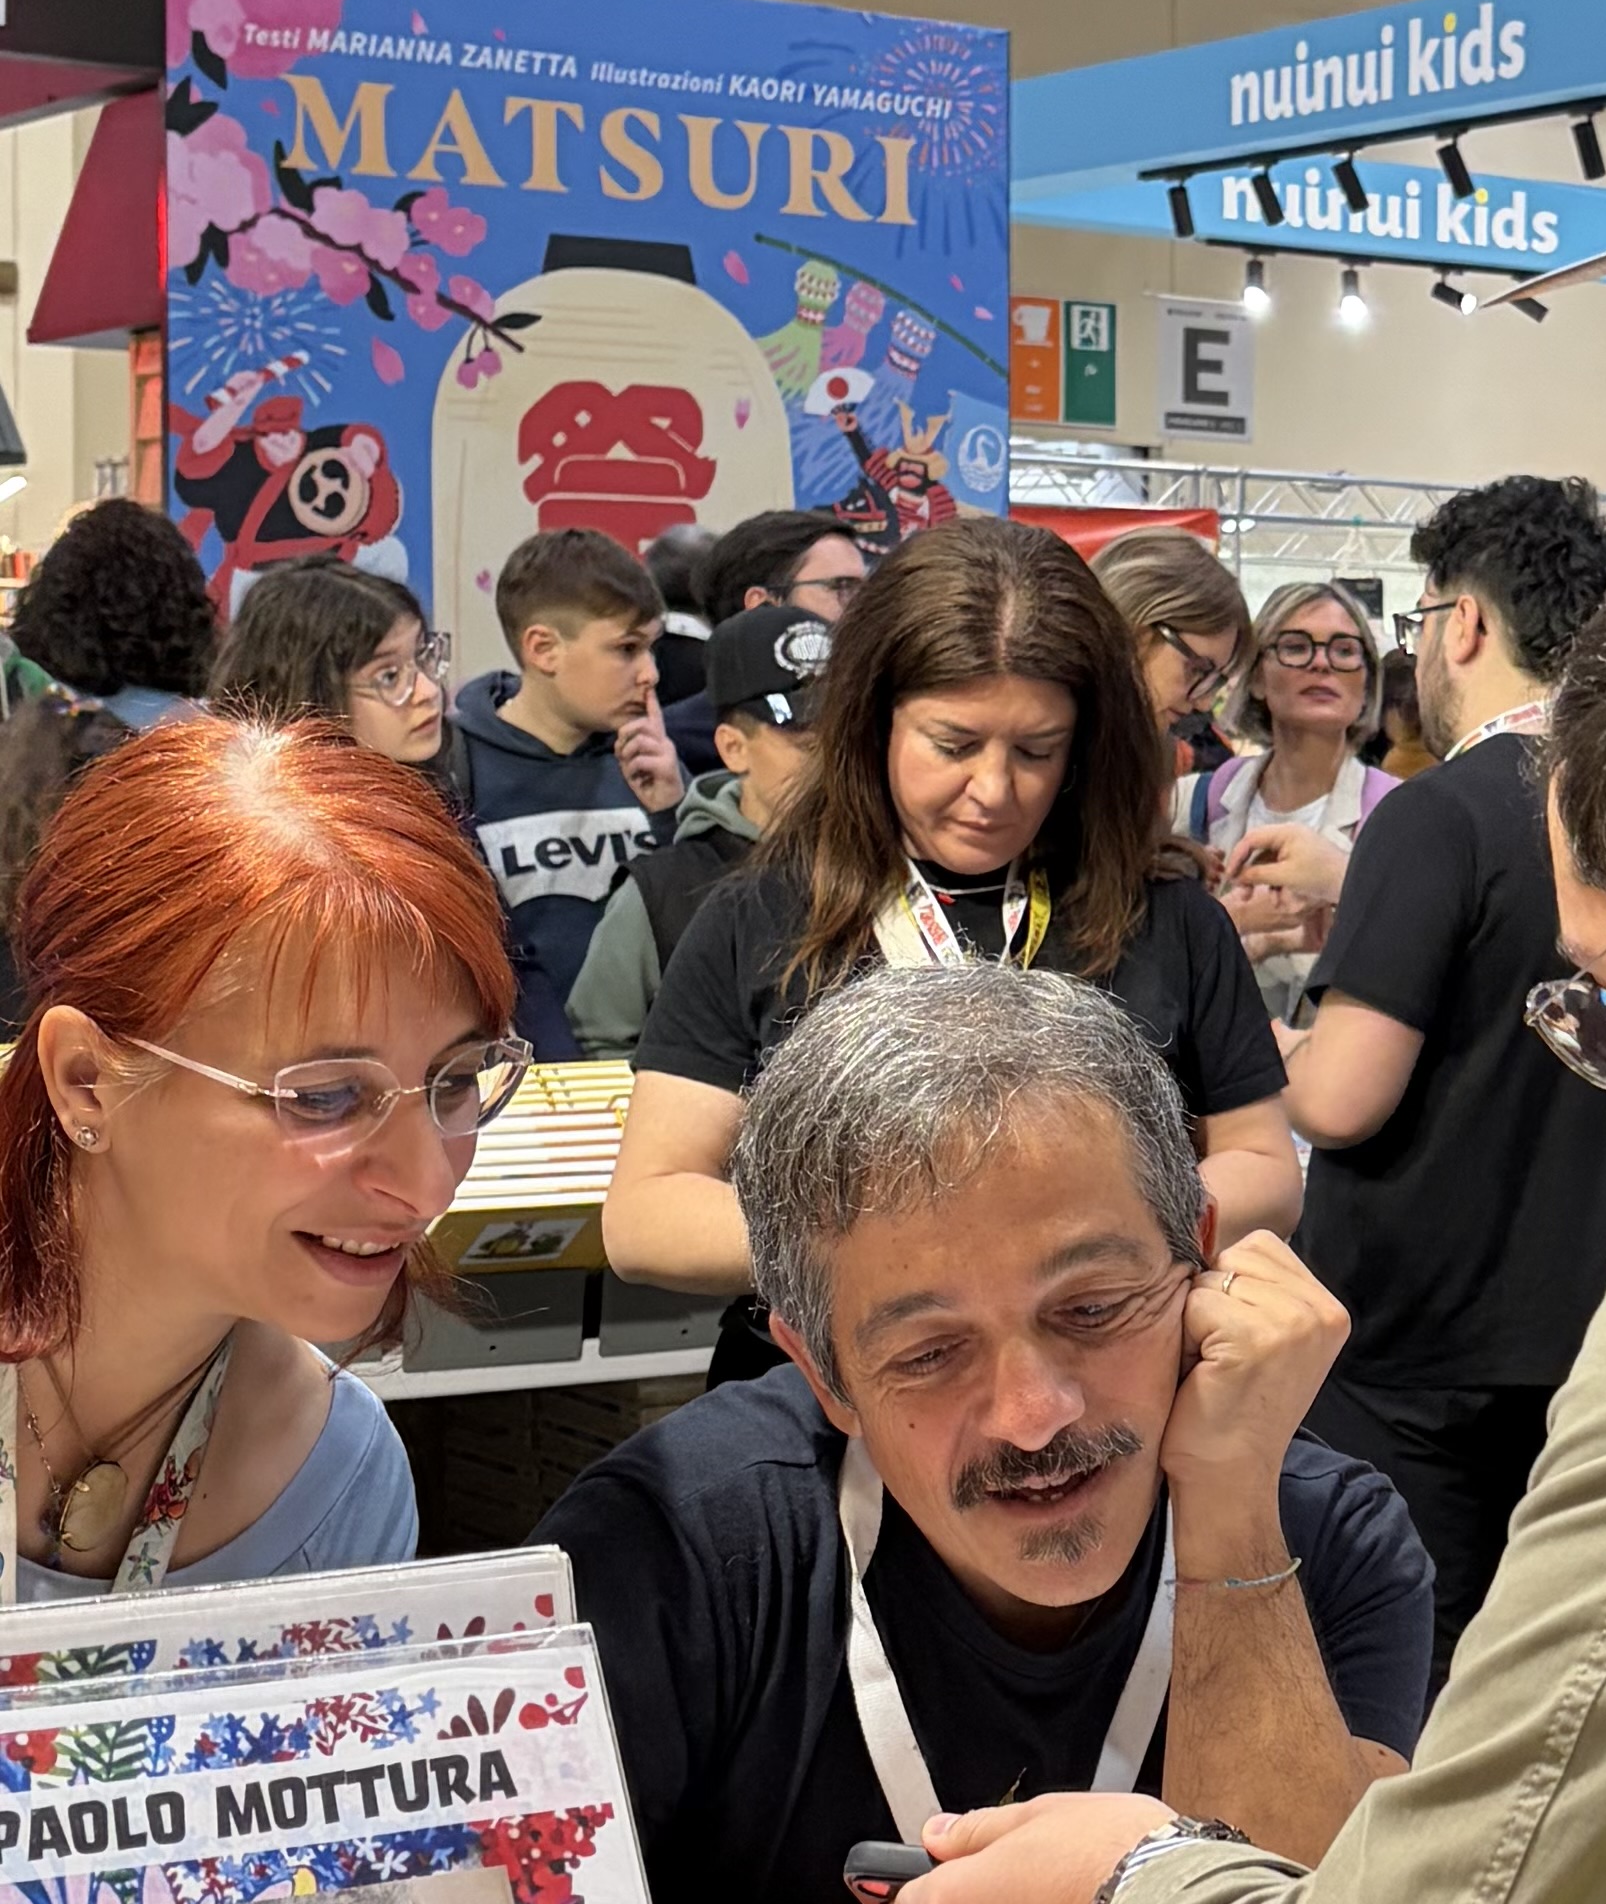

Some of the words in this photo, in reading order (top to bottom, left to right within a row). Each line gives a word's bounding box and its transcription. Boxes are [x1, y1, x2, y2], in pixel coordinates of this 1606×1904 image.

[243, 22, 302, 50] Testi
[306, 28, 452, 66] MARIANNA
[459, 42, 578, 80] ZANETTA
[590, 61, 724, 95] Illustrazioni
[728, 73, 807, 104] KAORI
[811, 83, 952, 121] YAMAGUCHI
[1230, 24, 1395, 127] nuinui
[1407, 2, 1527, 97] kids
[279, 72, 918, 226] MATSURI
[1436, 182, 1559, 254] kids
[1183, 327, 1231, 407] E
[216, 1748, 518, 1836] MOTTURA
